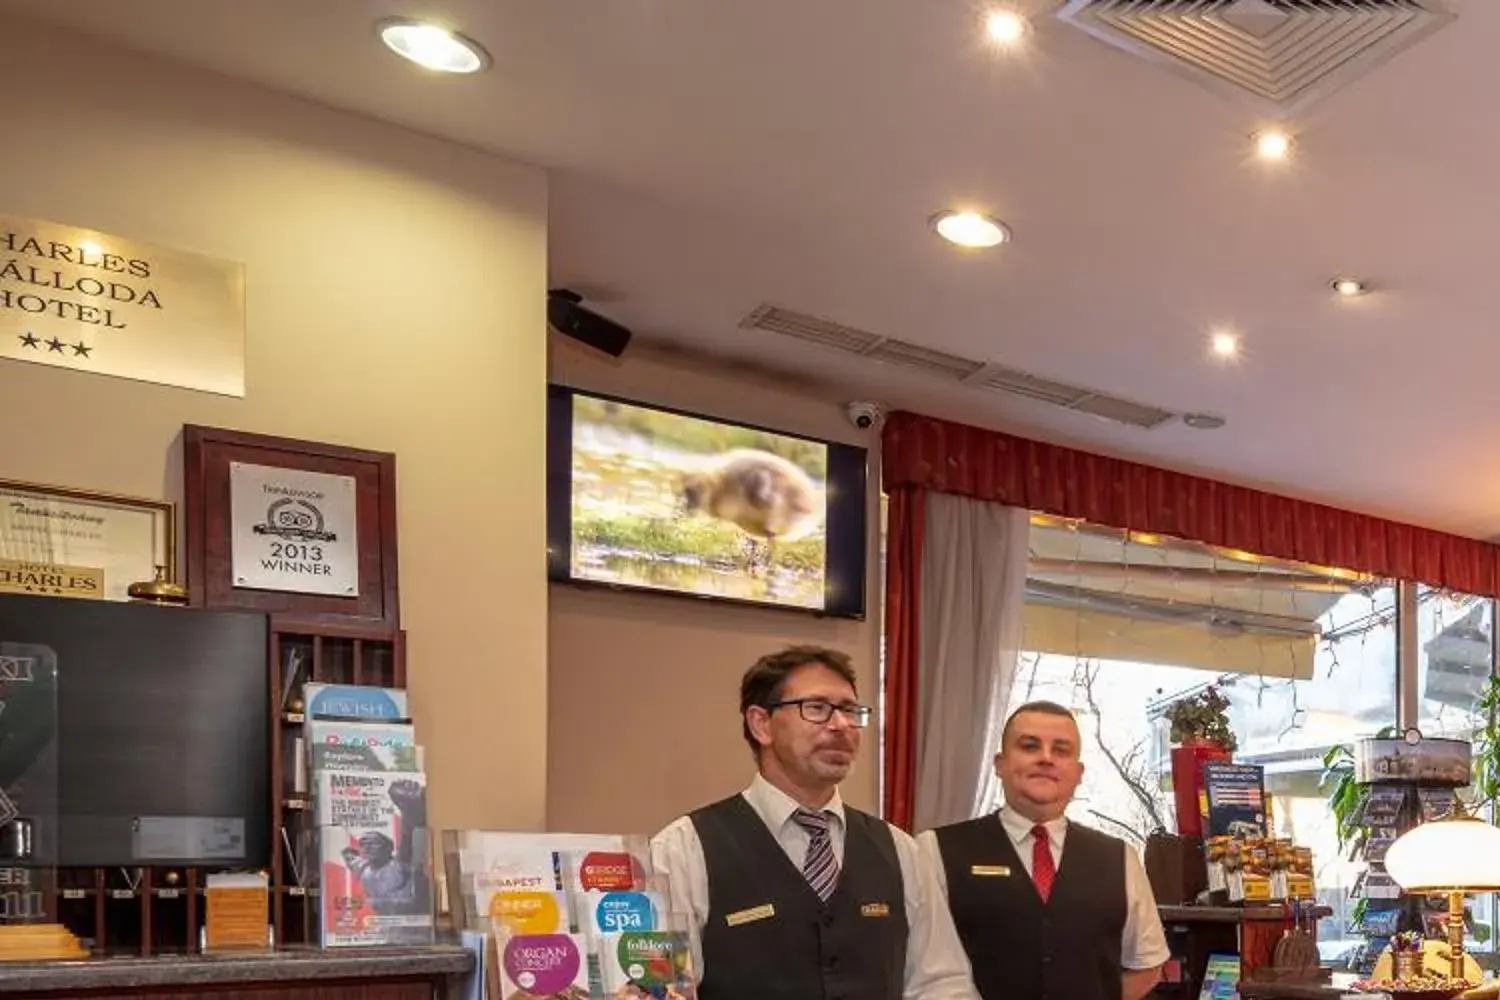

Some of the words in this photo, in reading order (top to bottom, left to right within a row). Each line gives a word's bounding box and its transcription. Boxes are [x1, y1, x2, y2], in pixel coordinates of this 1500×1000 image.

[269, 541, 323, 561] 2013
[261, 559, 333, 577] WINNER
[0, 569, 97, 590] HARLES
[605, 912, 642, 932] spa
[513, 947, 567, 960] ORGAN
